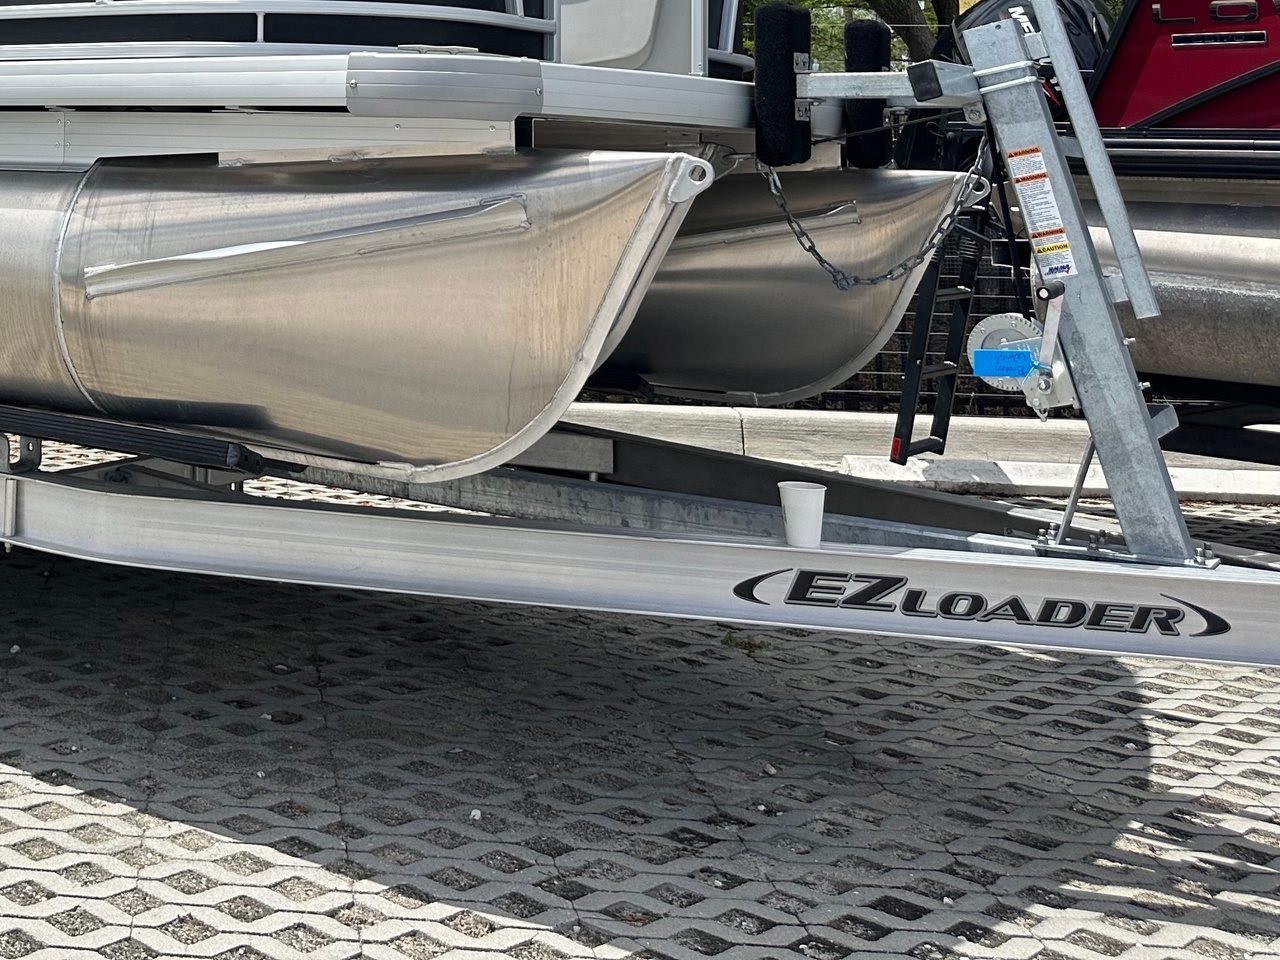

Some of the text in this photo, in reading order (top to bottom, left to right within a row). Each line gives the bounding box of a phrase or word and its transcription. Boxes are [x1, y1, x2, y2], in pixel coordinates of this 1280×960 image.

[1013, 147, 1039, 156] WARNING
[1020, 173, 1047, 182] WARNING
[1037, 229, 1064, 238] WARNING
[1042, 244, 1068, 252] CAUTION
